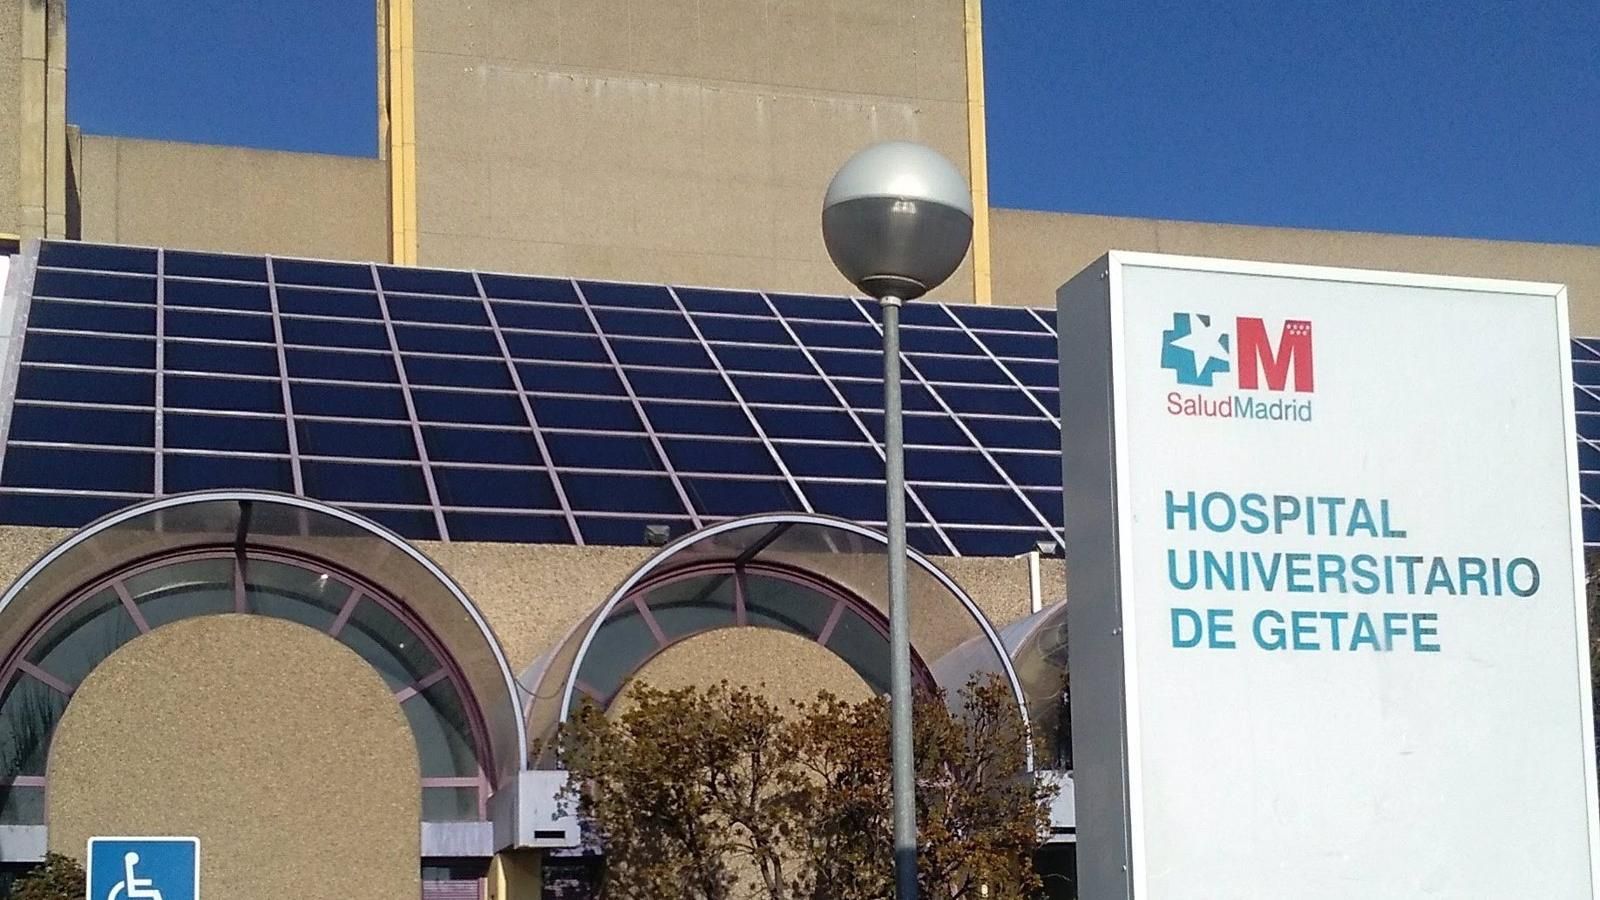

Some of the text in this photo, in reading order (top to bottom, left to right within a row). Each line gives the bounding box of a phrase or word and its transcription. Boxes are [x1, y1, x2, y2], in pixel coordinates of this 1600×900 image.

[1167, 392, 1312, 422] SaludMadrid
[1165, 490, 1407, 538] HOSPITAL
[1167, 549, 1541, 597] UNIVERSITARIO
[1171, 608, 1441, 652] DE GETAFE
